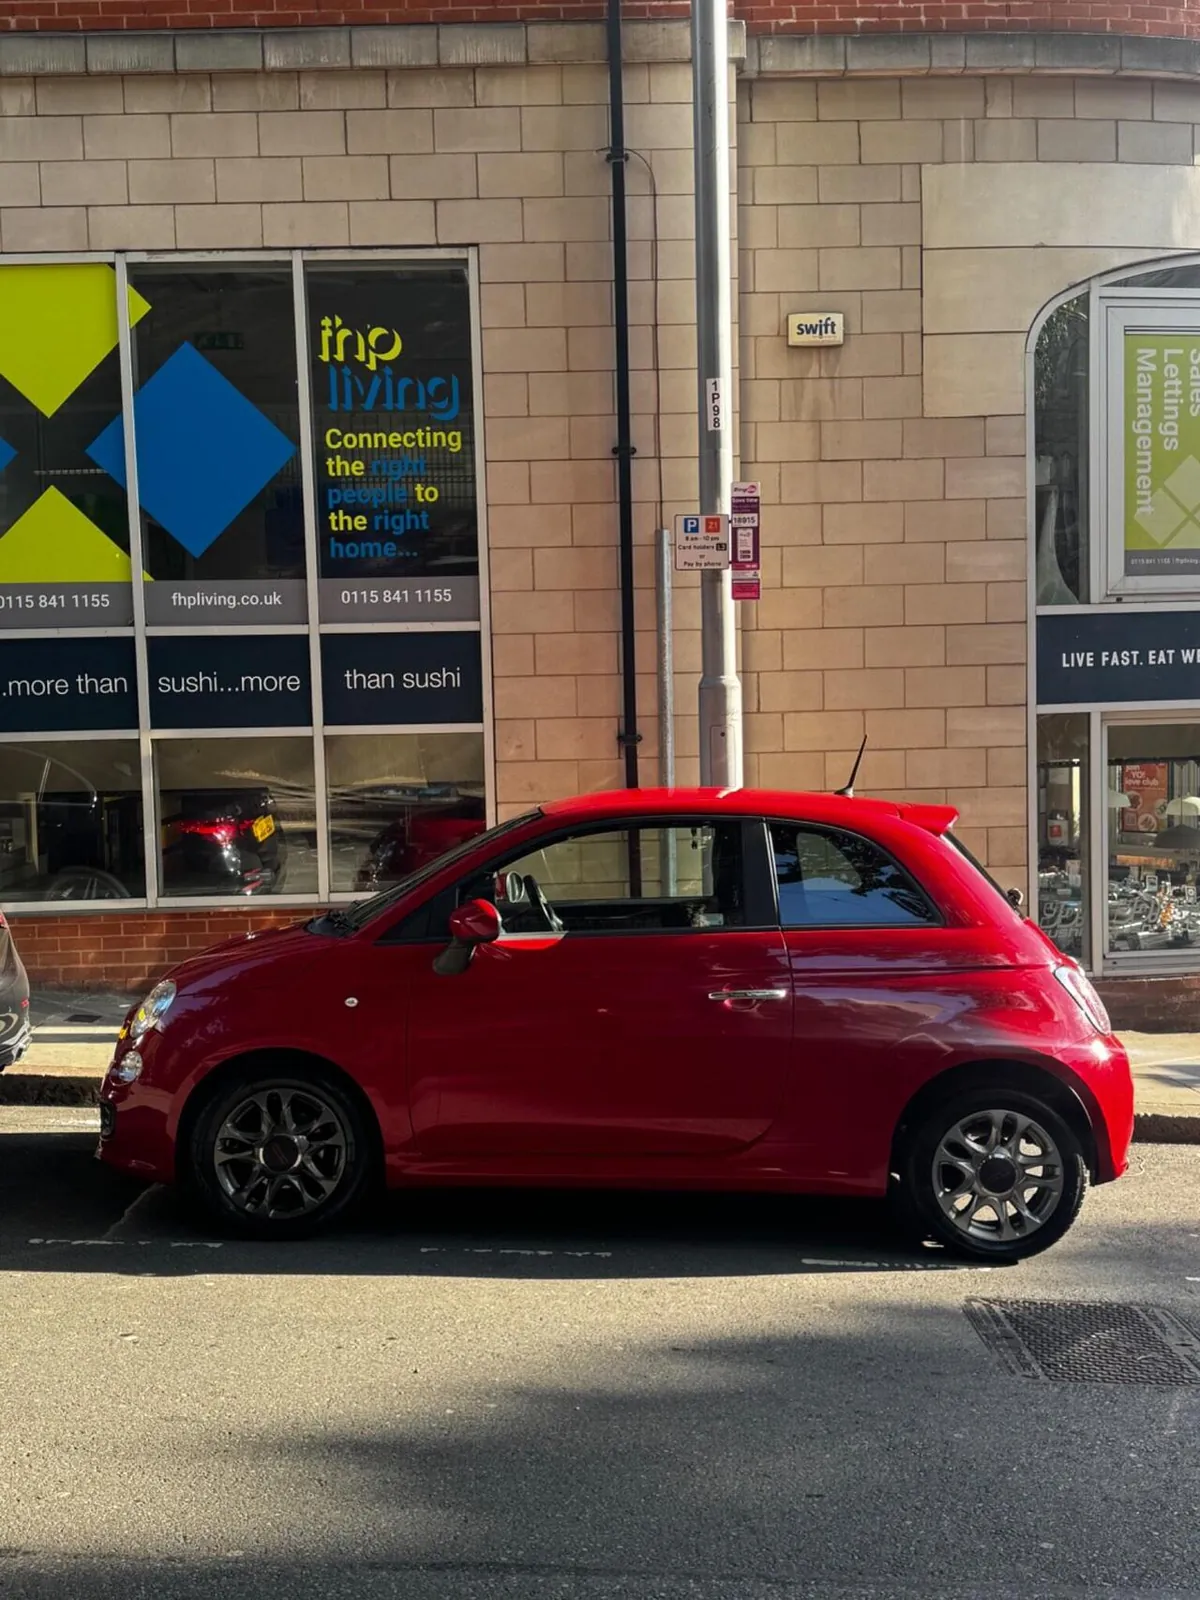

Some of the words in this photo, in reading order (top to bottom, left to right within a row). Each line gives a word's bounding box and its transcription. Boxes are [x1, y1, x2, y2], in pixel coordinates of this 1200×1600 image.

[796, 317, 836, 336] swift
[328, 364, 460, 421] living
[711, 380, 720, 428] 1P98
[1158, 348, 1184, 451] Lettings
[325, 426, 462, 453] Connecting
[1132, 348, 1157, 515] Management
[326, 455, 365, 476] the
[370, 454, 427, 480] right
[328, 481, 408, 509] people
[415, 483, 439, 502] to
[328, 510, 368, 531] the
[374, 509, 429, 535] right
[687, 519, 697, 532] P
[330, 536, 418, 558] home...
[38, 594, 65, 608] 841
[72, 594, 110, 608] 1155
[171, 591, 282, 609] fhpliving.co.uk
[341, 590, 379, 604] 0115
[382, 589, 409, 603] 841
[414, 588, 452, 602] 1155
[1062, 652, 1094, 668] LIVE
[1101, 650, 1144, 667] FAST.
[1148, 650, 1176, 665] EAT
[76, 673, 128, 695] than
[344, 668, 394, 690] than
[402, 666, 461, 688] sushi
